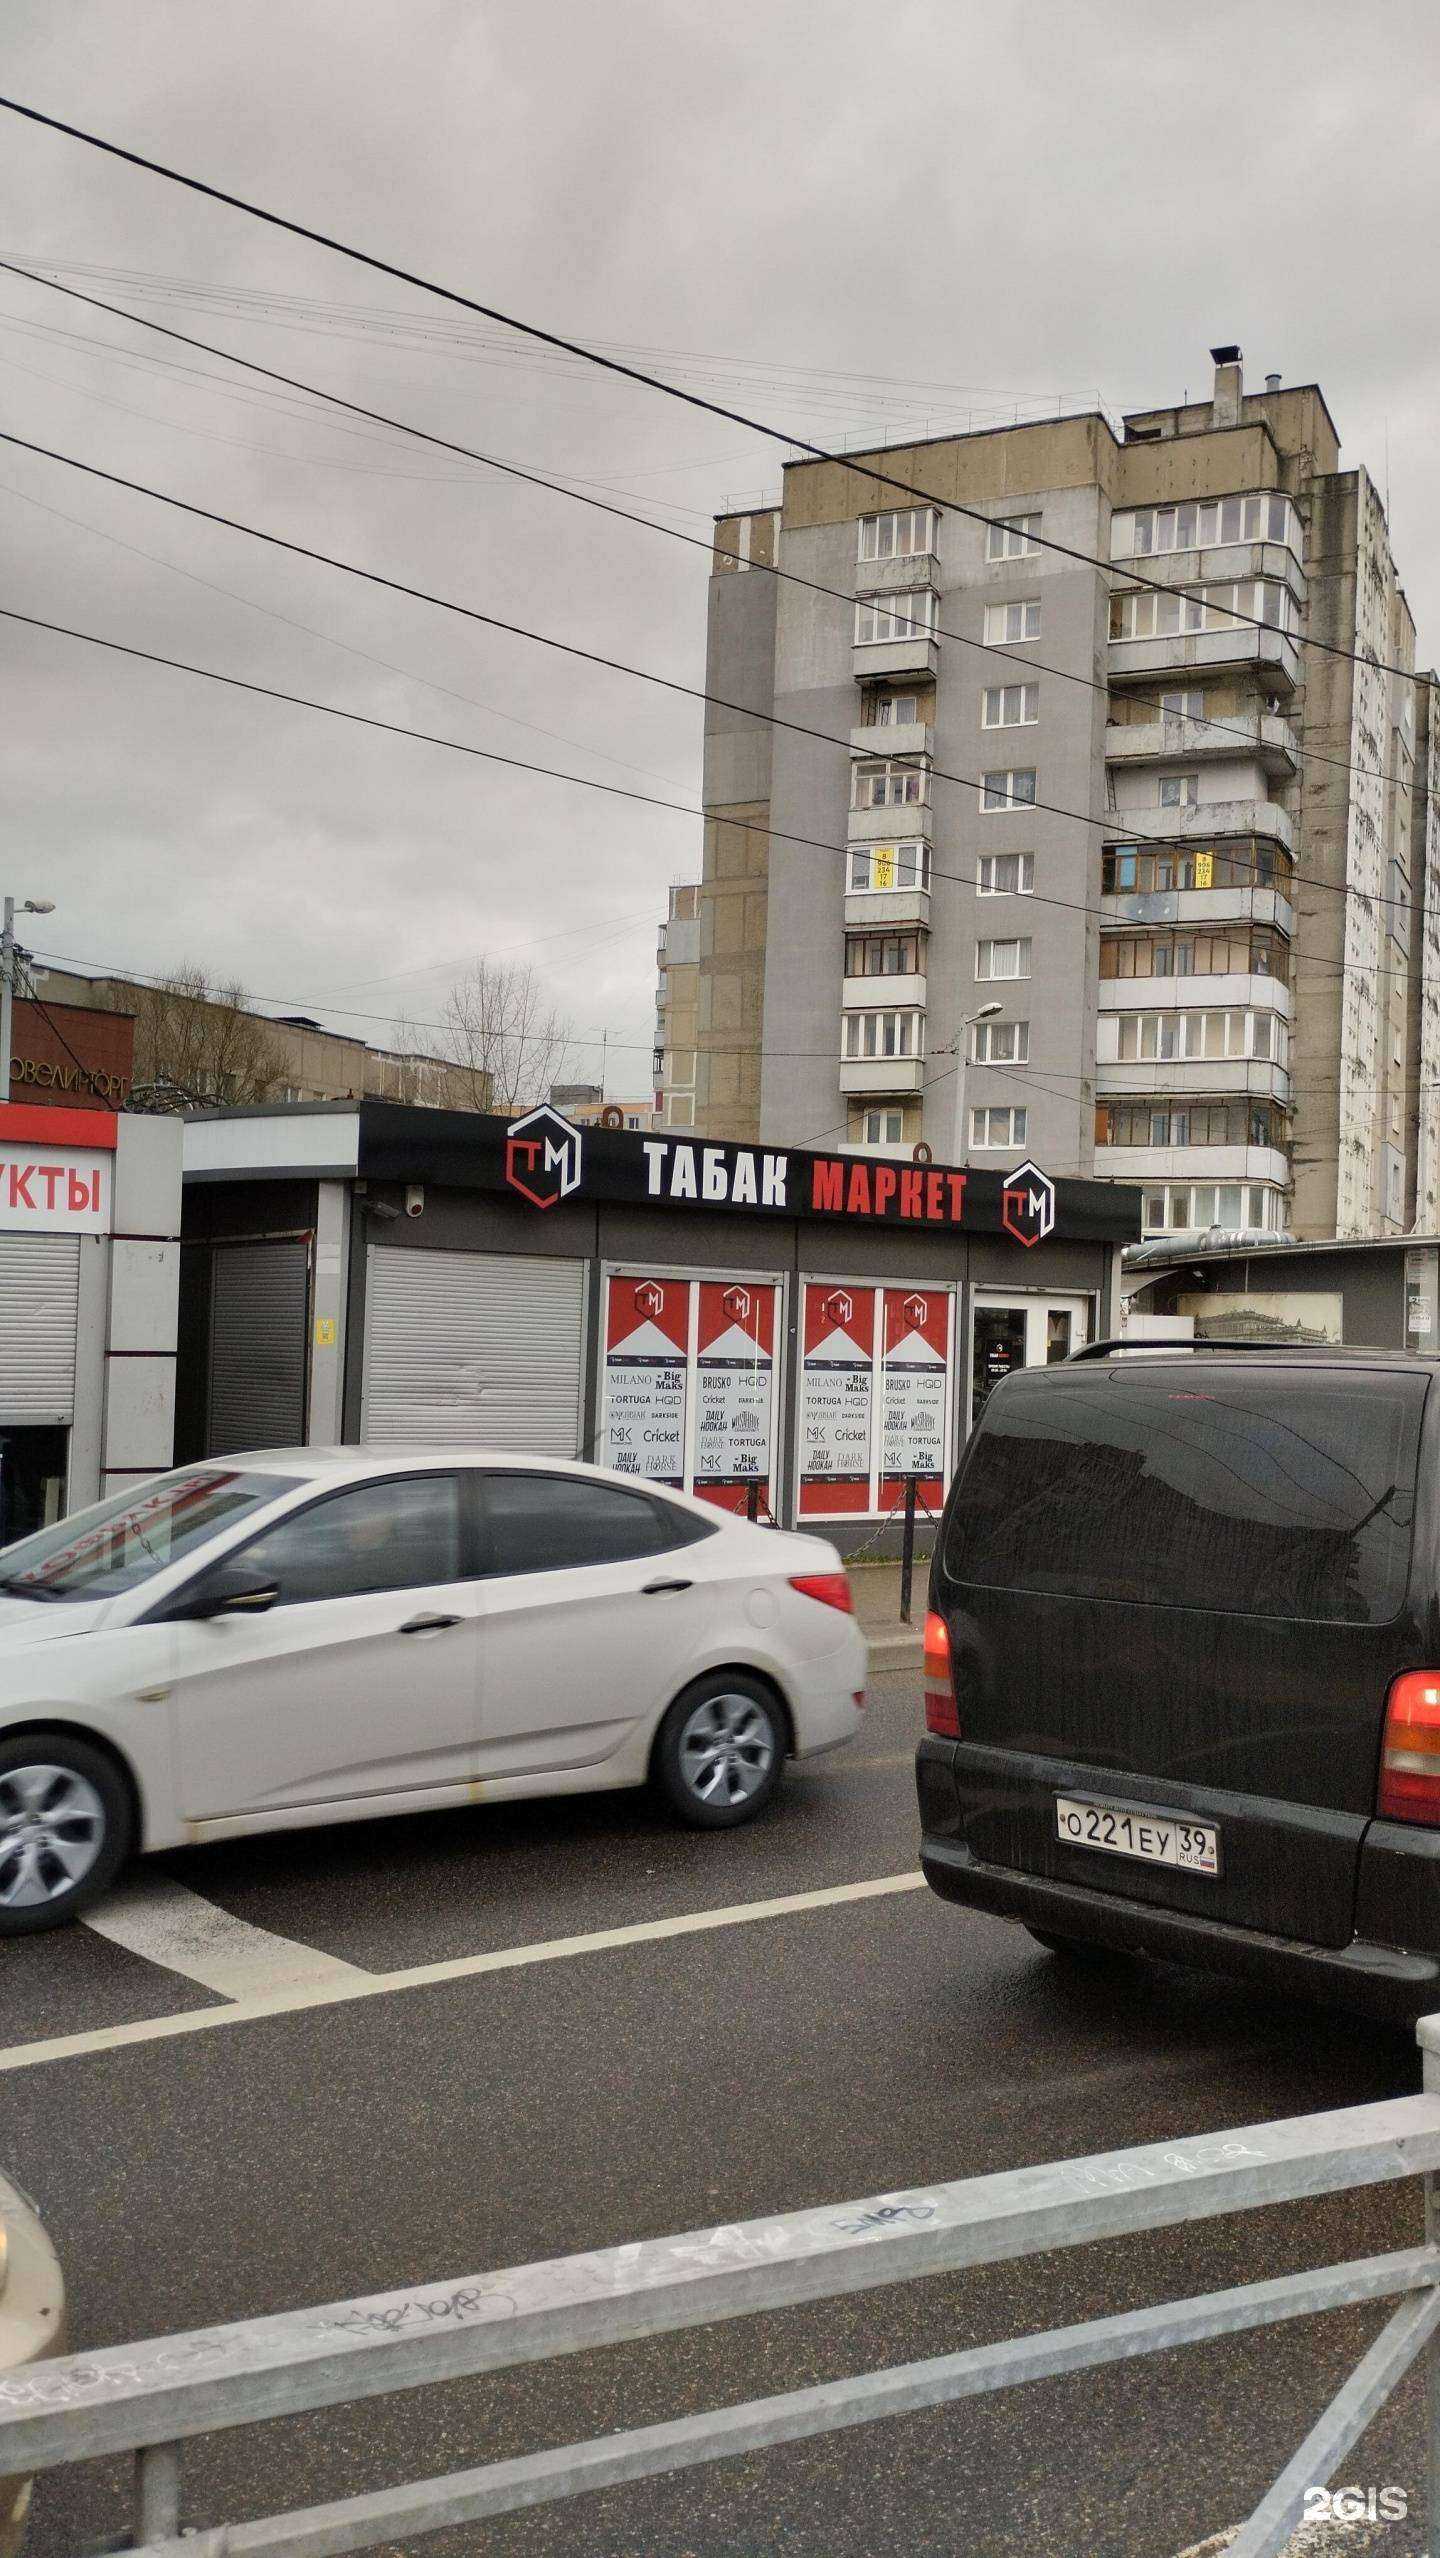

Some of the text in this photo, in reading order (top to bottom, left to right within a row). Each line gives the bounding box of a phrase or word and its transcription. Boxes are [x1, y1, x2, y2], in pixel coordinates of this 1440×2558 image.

[643, 1142, 966, 1221] ТАБАК МАРКЕТ
[0, 1164, 100, 1212] КТЫ
[610, 1374, 652, 1385] MILANO
[664, 1371, 682, 1384] Big
[703, 1376, 732, 1389] BRUSKO
[807, 1377, 843, 1387] MILANO
[852, 1375, 868, 1386] Big
[655, 1381, 683, 1390] Maks
[845, 1384, 869, 1392] Maks
[610, 1395, 651, 1404] TORTUGA
[807, 1396, 842, 1405] TORTUGA
[643, 1428, 680, 1442] Cricket
[835, 1428, 866, 1441] Cricket
[729, 1438, 766, 1447] TORTUGA
[908, 1437, 941, 1445] TORTUGA
[741, 1454, 758, 1465] Big
[919, 1452, 934, 1463] Big
[732, 1464, 759, 1473] Maks
[1179, 1825, 1206, 1856] 39
[1179, 1852, 1200, 1865] RUS
